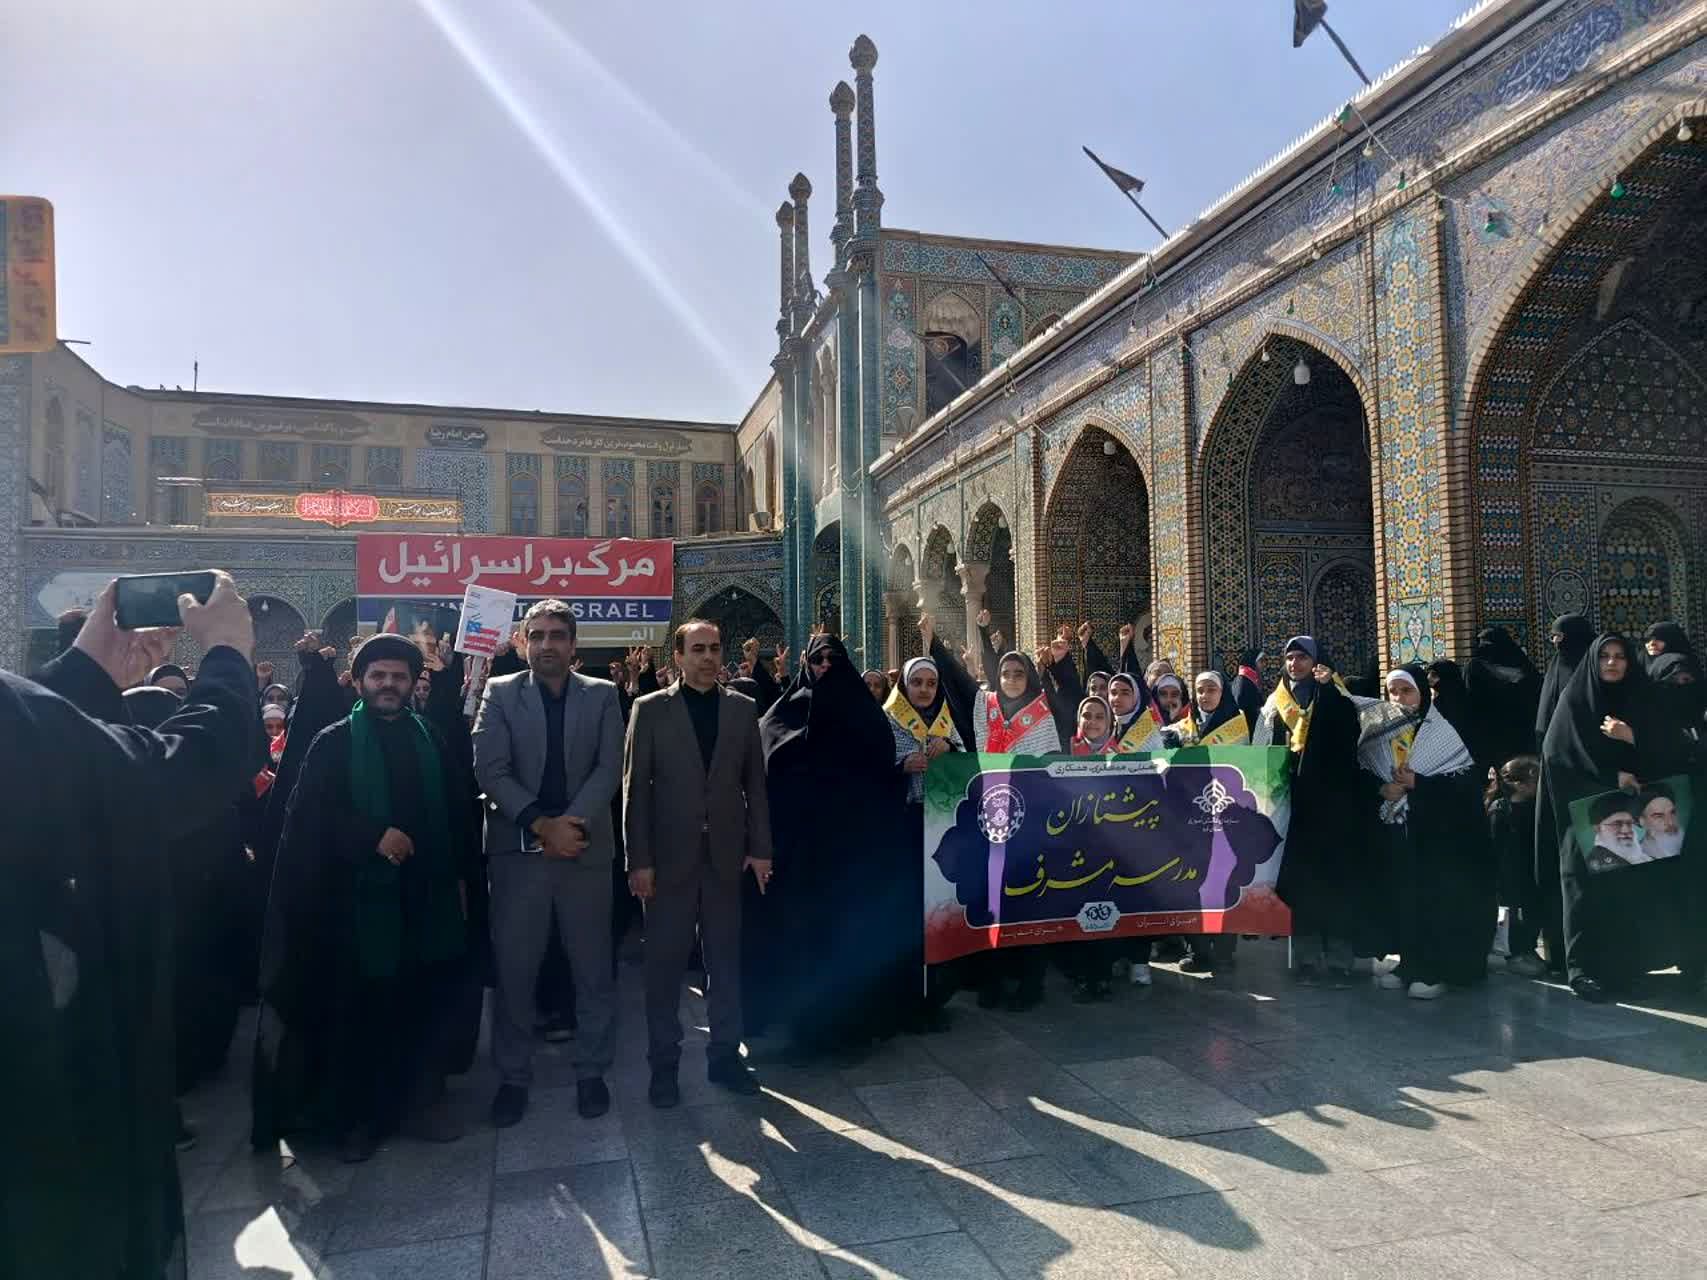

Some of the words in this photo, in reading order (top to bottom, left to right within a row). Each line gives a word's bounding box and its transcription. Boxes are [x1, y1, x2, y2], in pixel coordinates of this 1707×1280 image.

[378, 540, 533, 587] اسرائیل
[531, 555, 576, 587] بر
[575, 541, 655, 587] مرگ
[571, 602, 655, 618] SRAEL
[1045, 785, 1160, 836] پیشتازان
[1004, 850, 1115, 897] مشرف
[1105, 856, 1198, 896] مدرسه
